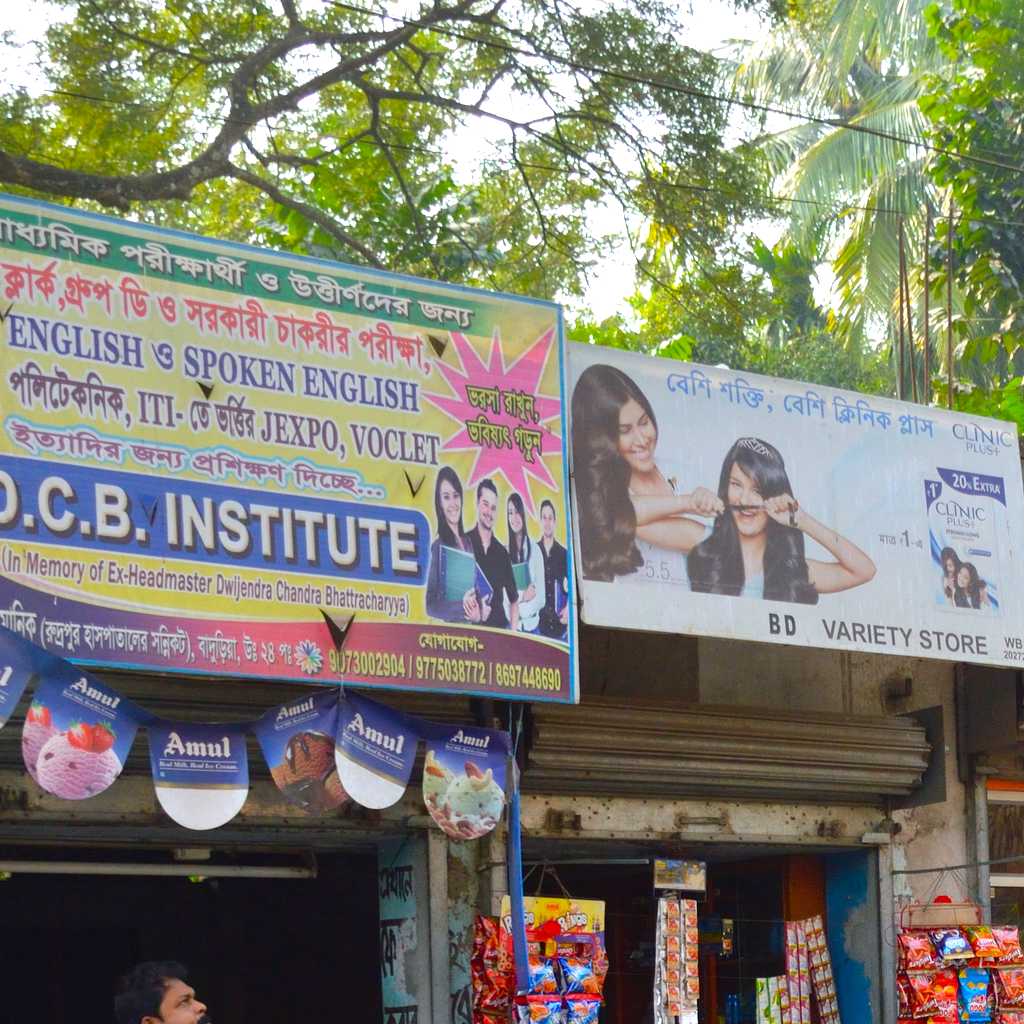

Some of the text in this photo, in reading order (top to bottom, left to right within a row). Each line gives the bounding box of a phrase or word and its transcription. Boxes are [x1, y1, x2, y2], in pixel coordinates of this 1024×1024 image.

[0, 217, 474, 328] াধ্যমিক পরীক্ষার্থী ও উত্তীর্ণদের জন্য
[120, 276, 149, 318] ডি
[158, 295, 176, 323] ও
[183, 297, 268, 344] সরকারী
[274, 311, 351, 356] চাকরীর
[359, 322, 432, 375] পরীক্ষা,
[8, 314, 421, 413] ENGLISH ও SPOKEN ENGLISH
[465, 384, 501, 415] ভরসা
[666, 369, 712, 398] বেশি
[783, 391, 826, 418] বেশি
[833, 396, 891, 430] ক্লিনিক
[898, 413, 935, 438] প্লাস
[190, 399, 210, 431] তে
[261, 411, 347, 460] JEXPO,
[350, 424, 441, 466] VOCLET
[952, 422, 1013, 448] CLINIC
[11, 421, 122, 461] ইত্যাদির
[130, 443, 186, 469] জন্য
[193, 450, 284, 483] প্রশিক্ষণ
[935, 501, 987, 523] CLINIC
[165, 492, 419, 574] INSTITUTE
[26, 551, 85, 585] Memory
[89, 559, 105, 582] of
[108, 561, 212, 594] Ex-Headmaster
[216, 574, 272, 602] Dwijendra
[276, 580, 321, 606] Chandra
[821, 619, 913, 650] VARIETY
[919, 630, 988, 656] STORE
[1003, 636, 1024, 650] WB
[416, 655, 486, 685] 9775038772
[496, 663, 561, 691] 8697448690
[69, 677, 122, 710] Amul
[276, 697, 314, 722] Amul
[163, 731, 232, 759] Amul
[346, 712, 405, 755] Amul
[451, 729, 491, 750] Amul
